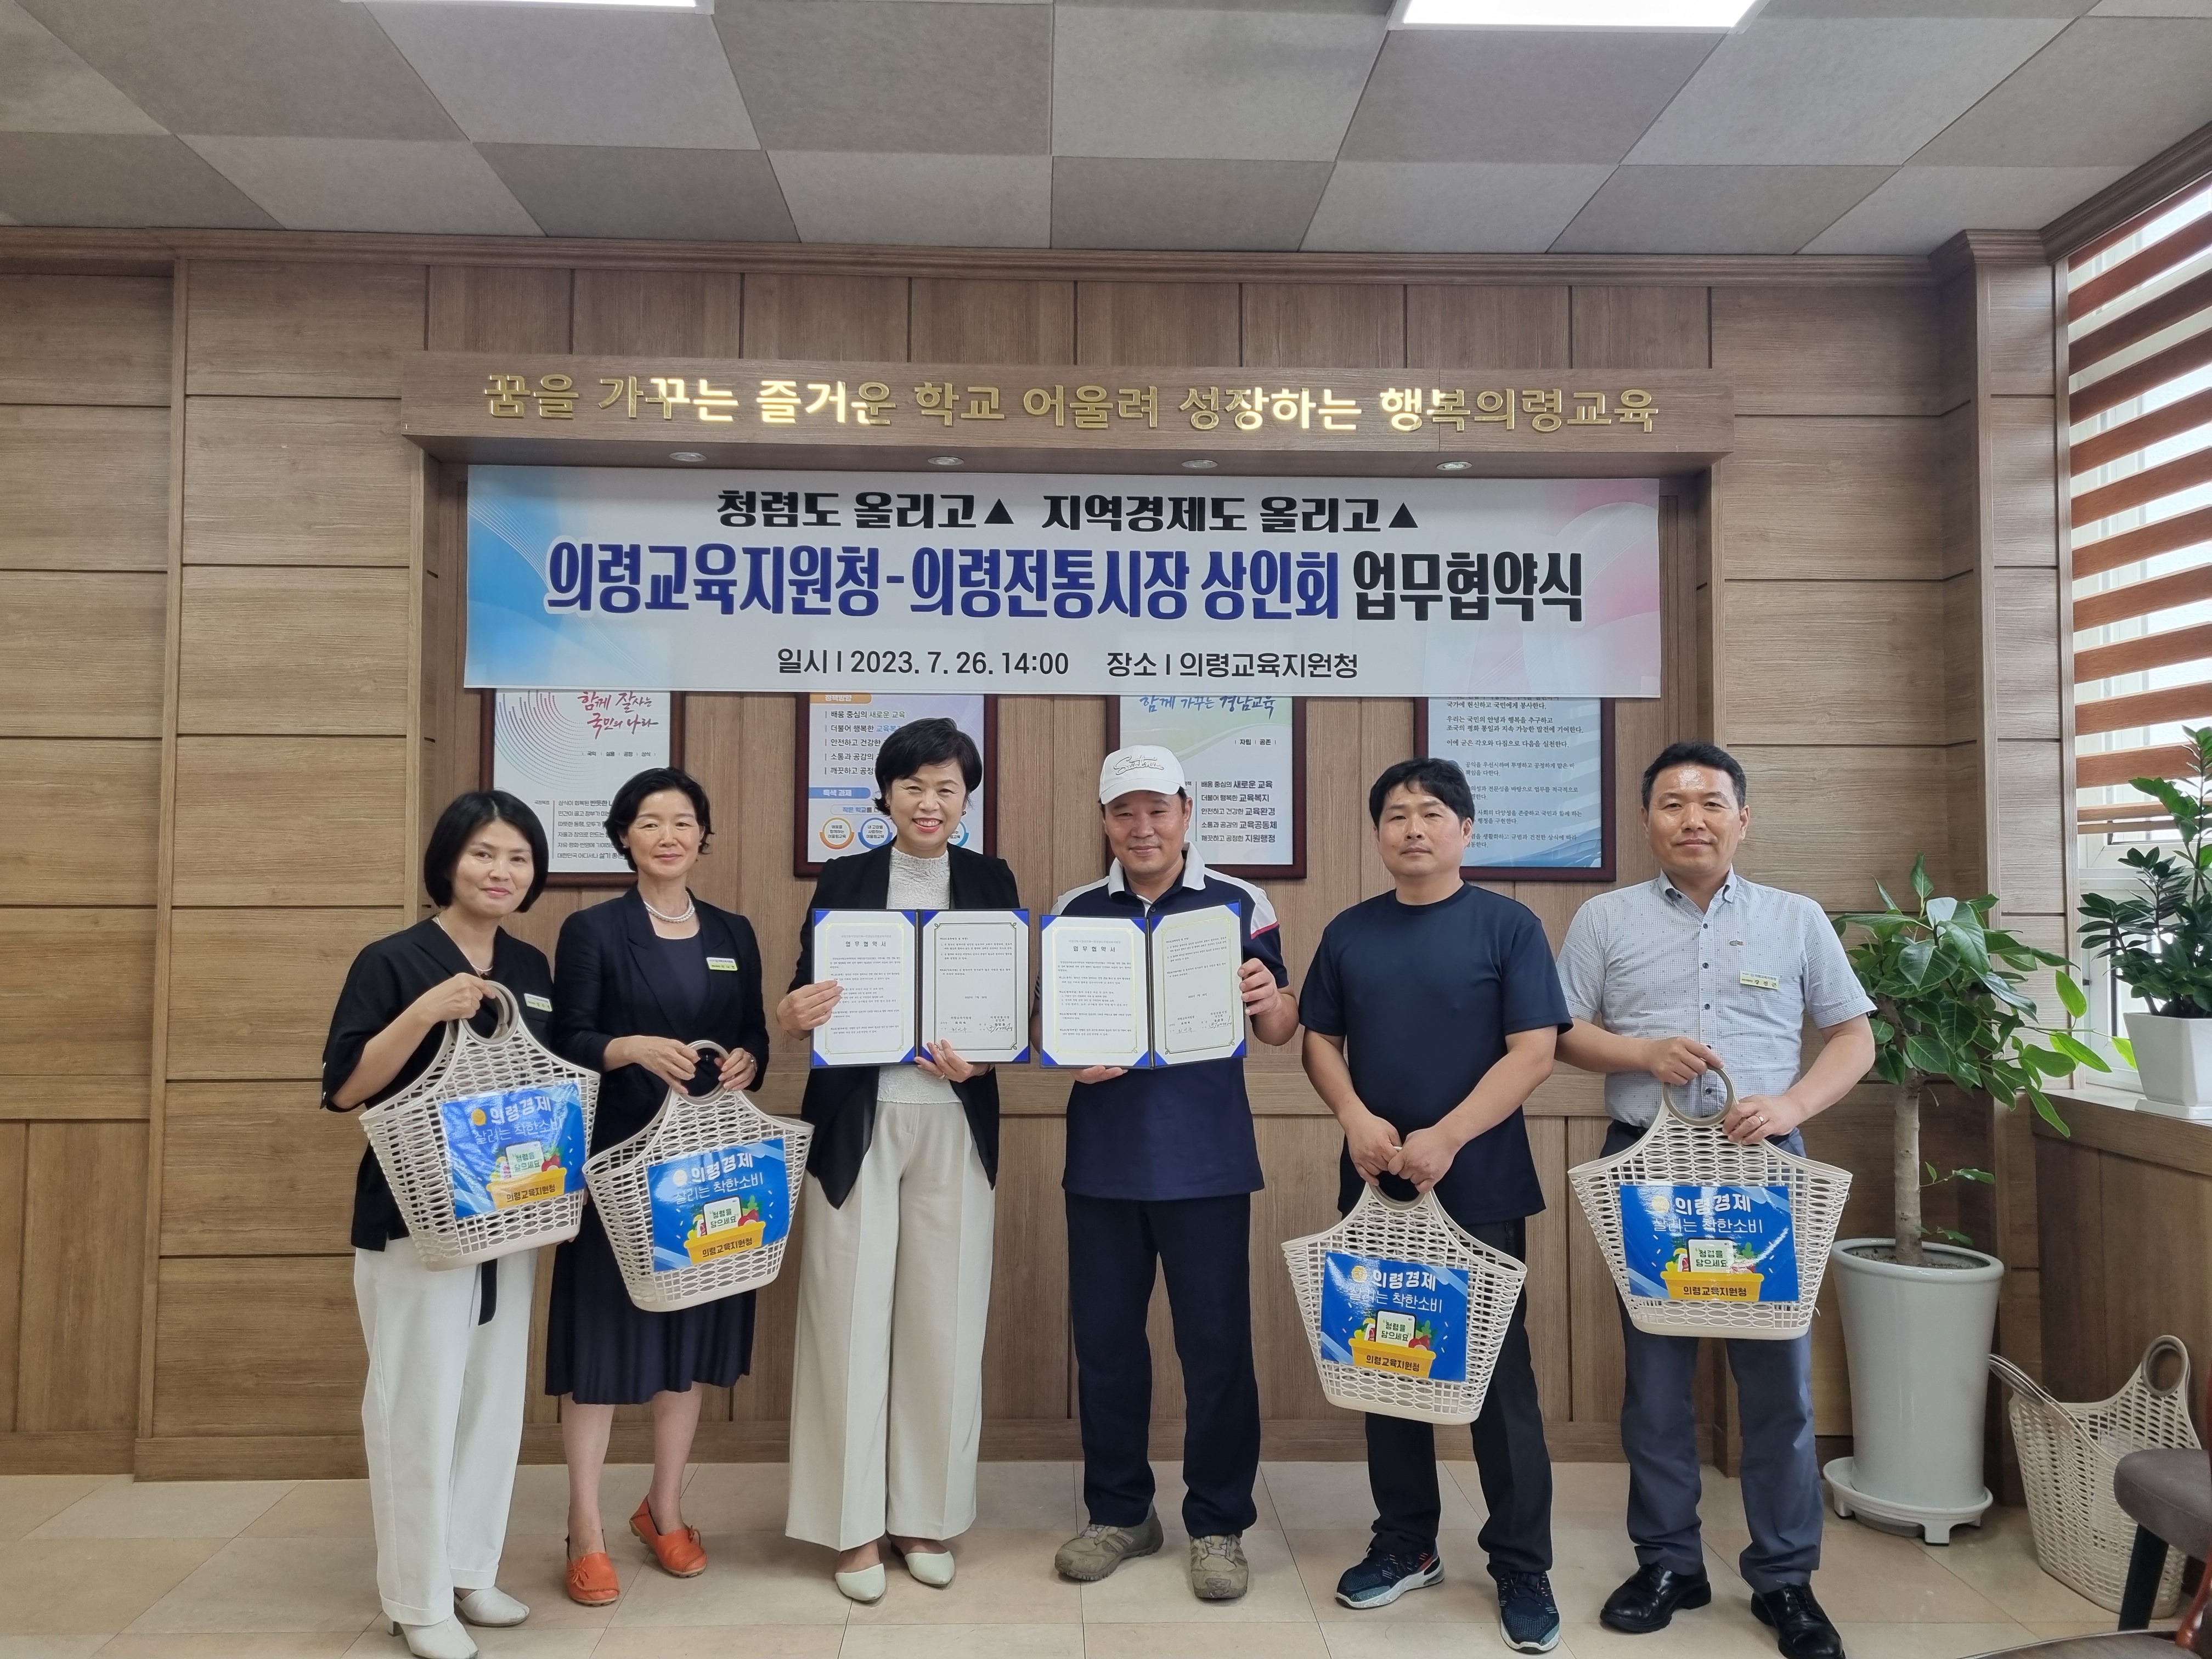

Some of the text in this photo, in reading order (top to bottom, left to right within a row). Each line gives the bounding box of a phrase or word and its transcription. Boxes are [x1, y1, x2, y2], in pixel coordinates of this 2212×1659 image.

[484, 374, 1658, 433] 꿈을 가꾸는 즐거운 학교 어울려 성장하는 행복의령교육
[717, 489, 841, 528] 청렴도
[1042, 495, 1247, 532] 지역경제도
[1201, 550, 1339, 620] 상인회
[1353, 551, 1582, 622] 업무협약식
[1107, 652, 1156, 678] 장소
[1179, 653, 1358, 679] 의령교육지원청
[578, 691, 612, 711] 함께
[1139, 696, 1276, 720] 함께 가꾸는 경남교육
[587, 713, 659, 740] 국민의 나라
[1239, 794, 1269, 802] 교육복지
[1245, 808, 1276, 816] 교육환경
[1245, 834, 1276, 843] 지원행정
[490, 1096, 552, 1124] 의령경제
[475, 1117, 563, 1145] 살리는 착한소비
[691, 1153, 753, 1183] 의령경제
[714, 1172, 764, 1193] 착한소비
[506, 1184, 556, 1203] 의령교육지원청
[1675, 1193, 1752, 1216] 의령경제
[1702, 1217, 1763, 1234] 착한소비
[702, 1238, 753, 1258] 의령교육지원청
[1372, 1270, 1436, 1292] 의령경제
[1683, 1285, 1747, 1297] 의령교육지원청
[1392, 1292, 1442, 1313] 착한소비
[1365, 1354, 1420, 1372] 의령교육지원청
